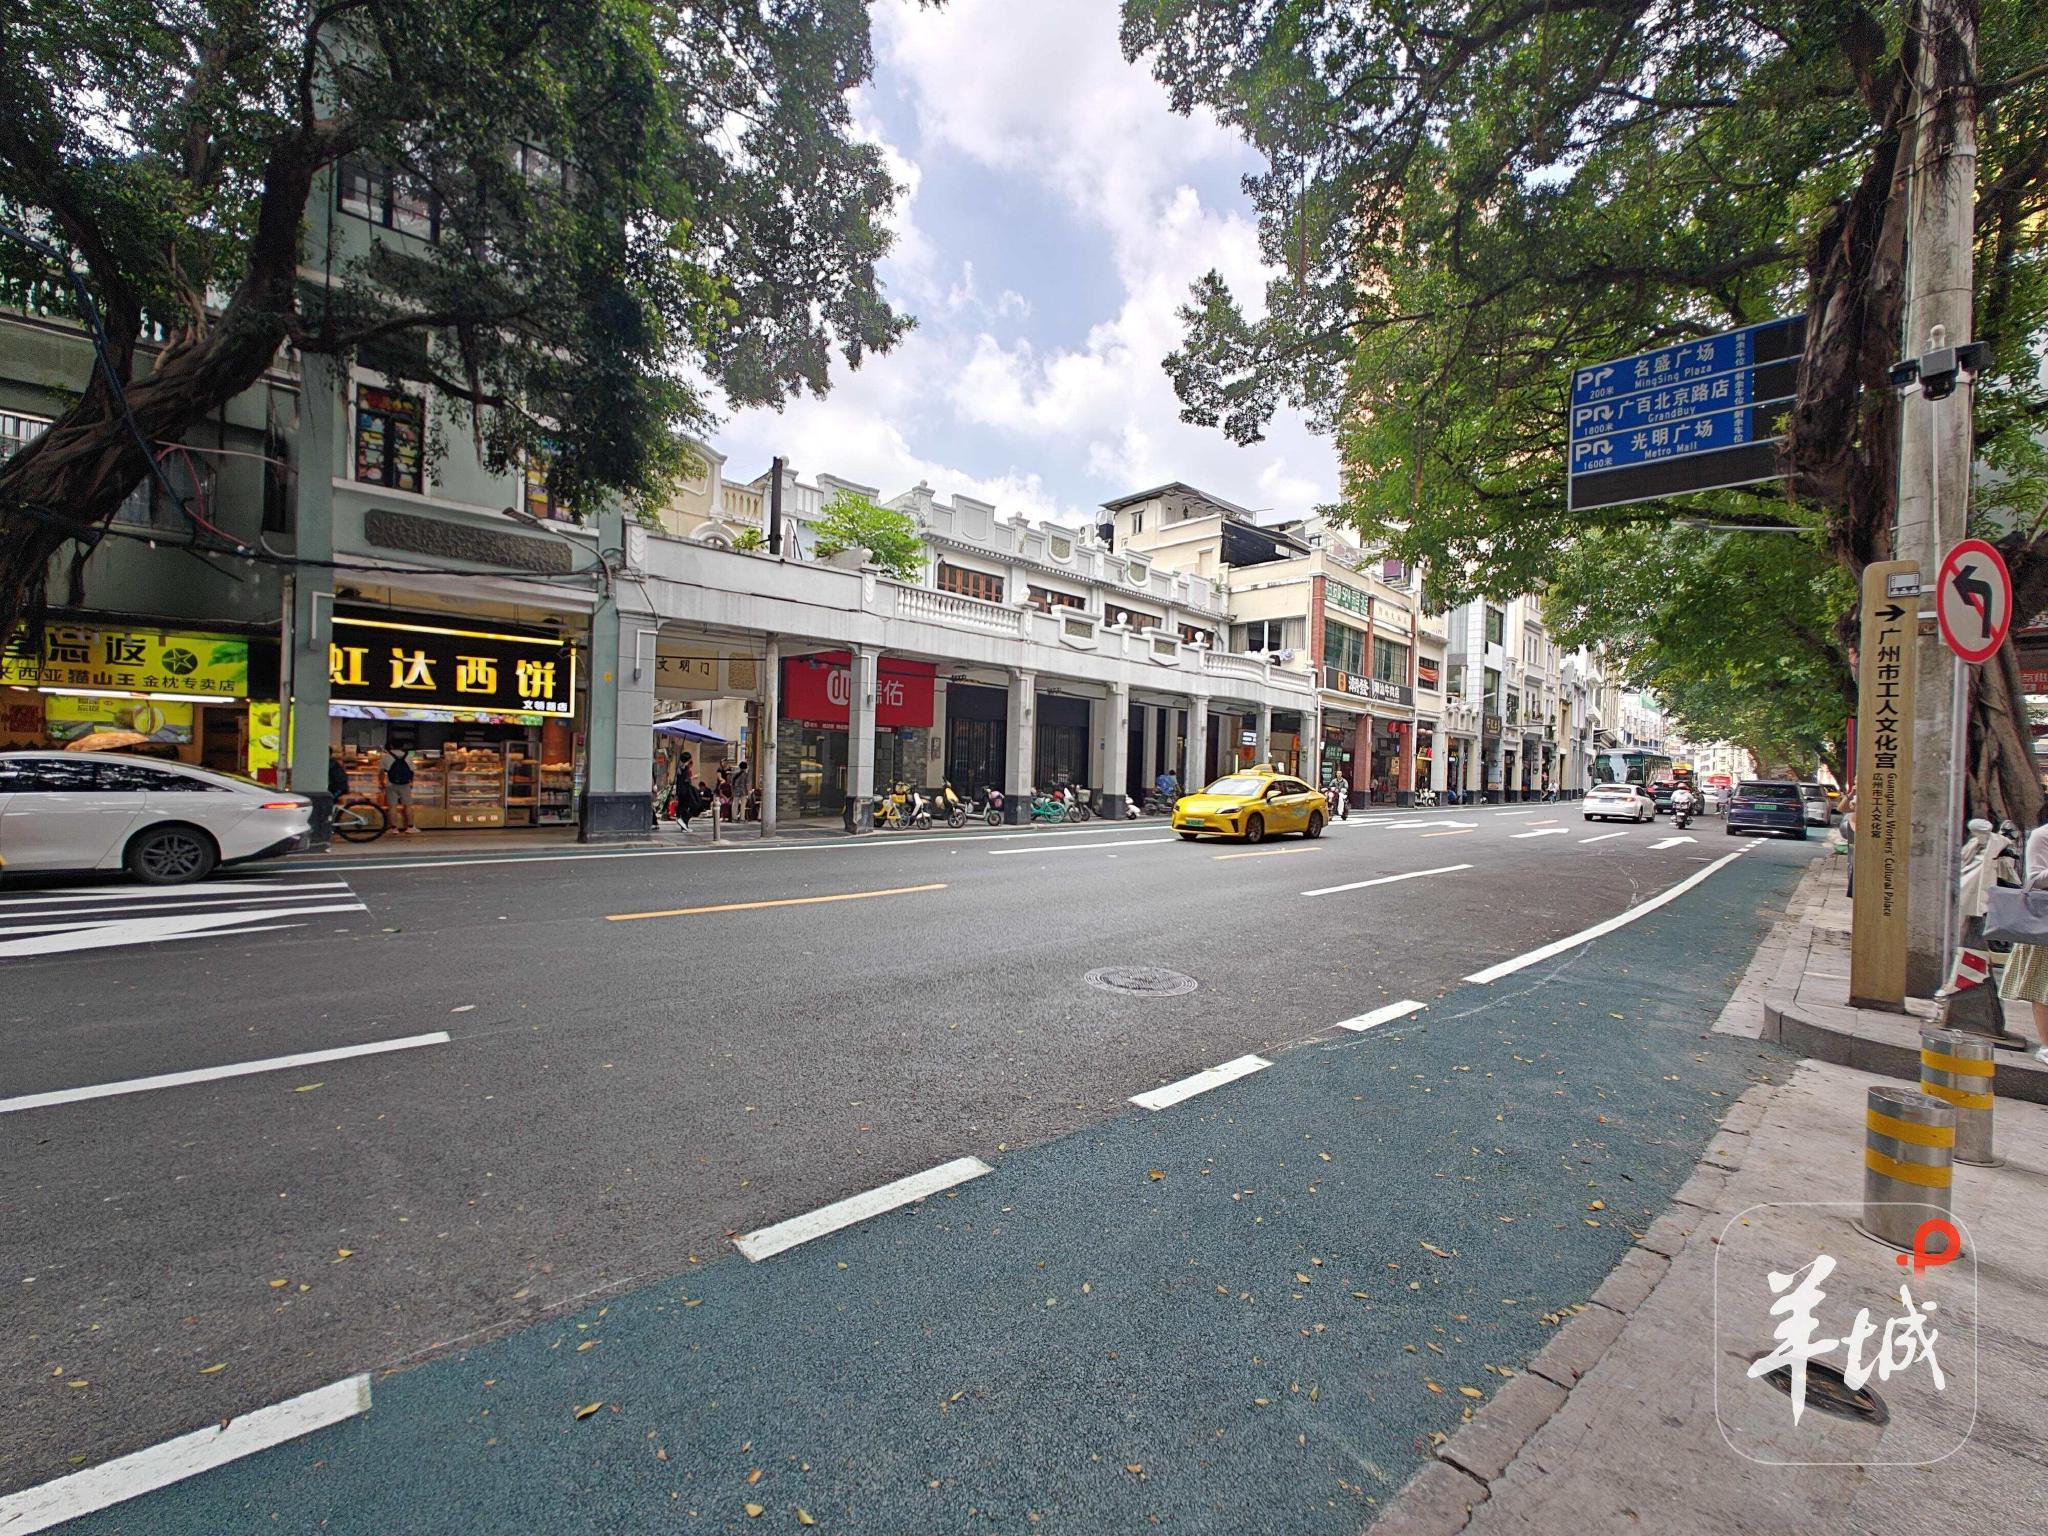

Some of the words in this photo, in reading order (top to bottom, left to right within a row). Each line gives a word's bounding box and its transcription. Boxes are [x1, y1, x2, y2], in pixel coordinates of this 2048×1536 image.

[1635, 344, 1713, 377] 名盛广场
[1635, 372, 1680, 389] MingSing
[1684, 364, 1712, 377] Plaza
[1590, 387, 1614, 399] 200米
[1618, 380, 1729, 418] 广百北京路店
[1648, 406, 1695, 423] GrandBuy
[1584, 423, 1614, 436] 1800米
[1632, 420, 1712, 451] 光明广场
[1584, 457, 1613, 470] 1600米
[1644, 446, 1672, 460] Metro
[1676, 442, 1698, 453] Mall
[329, 642, 557, 700] 虹达西饼
[656, 656, 711, 675] 文明门
[143, 675, 236, 692] 金枕专卖店
[1874, 628, 1902, 769] 广州市工人文化宫
[1884, 773, 1898, 817] Guangzhou
[1883, 858, 1895, 890] Cultural
[1882, 890, 1894, 917] Palace
